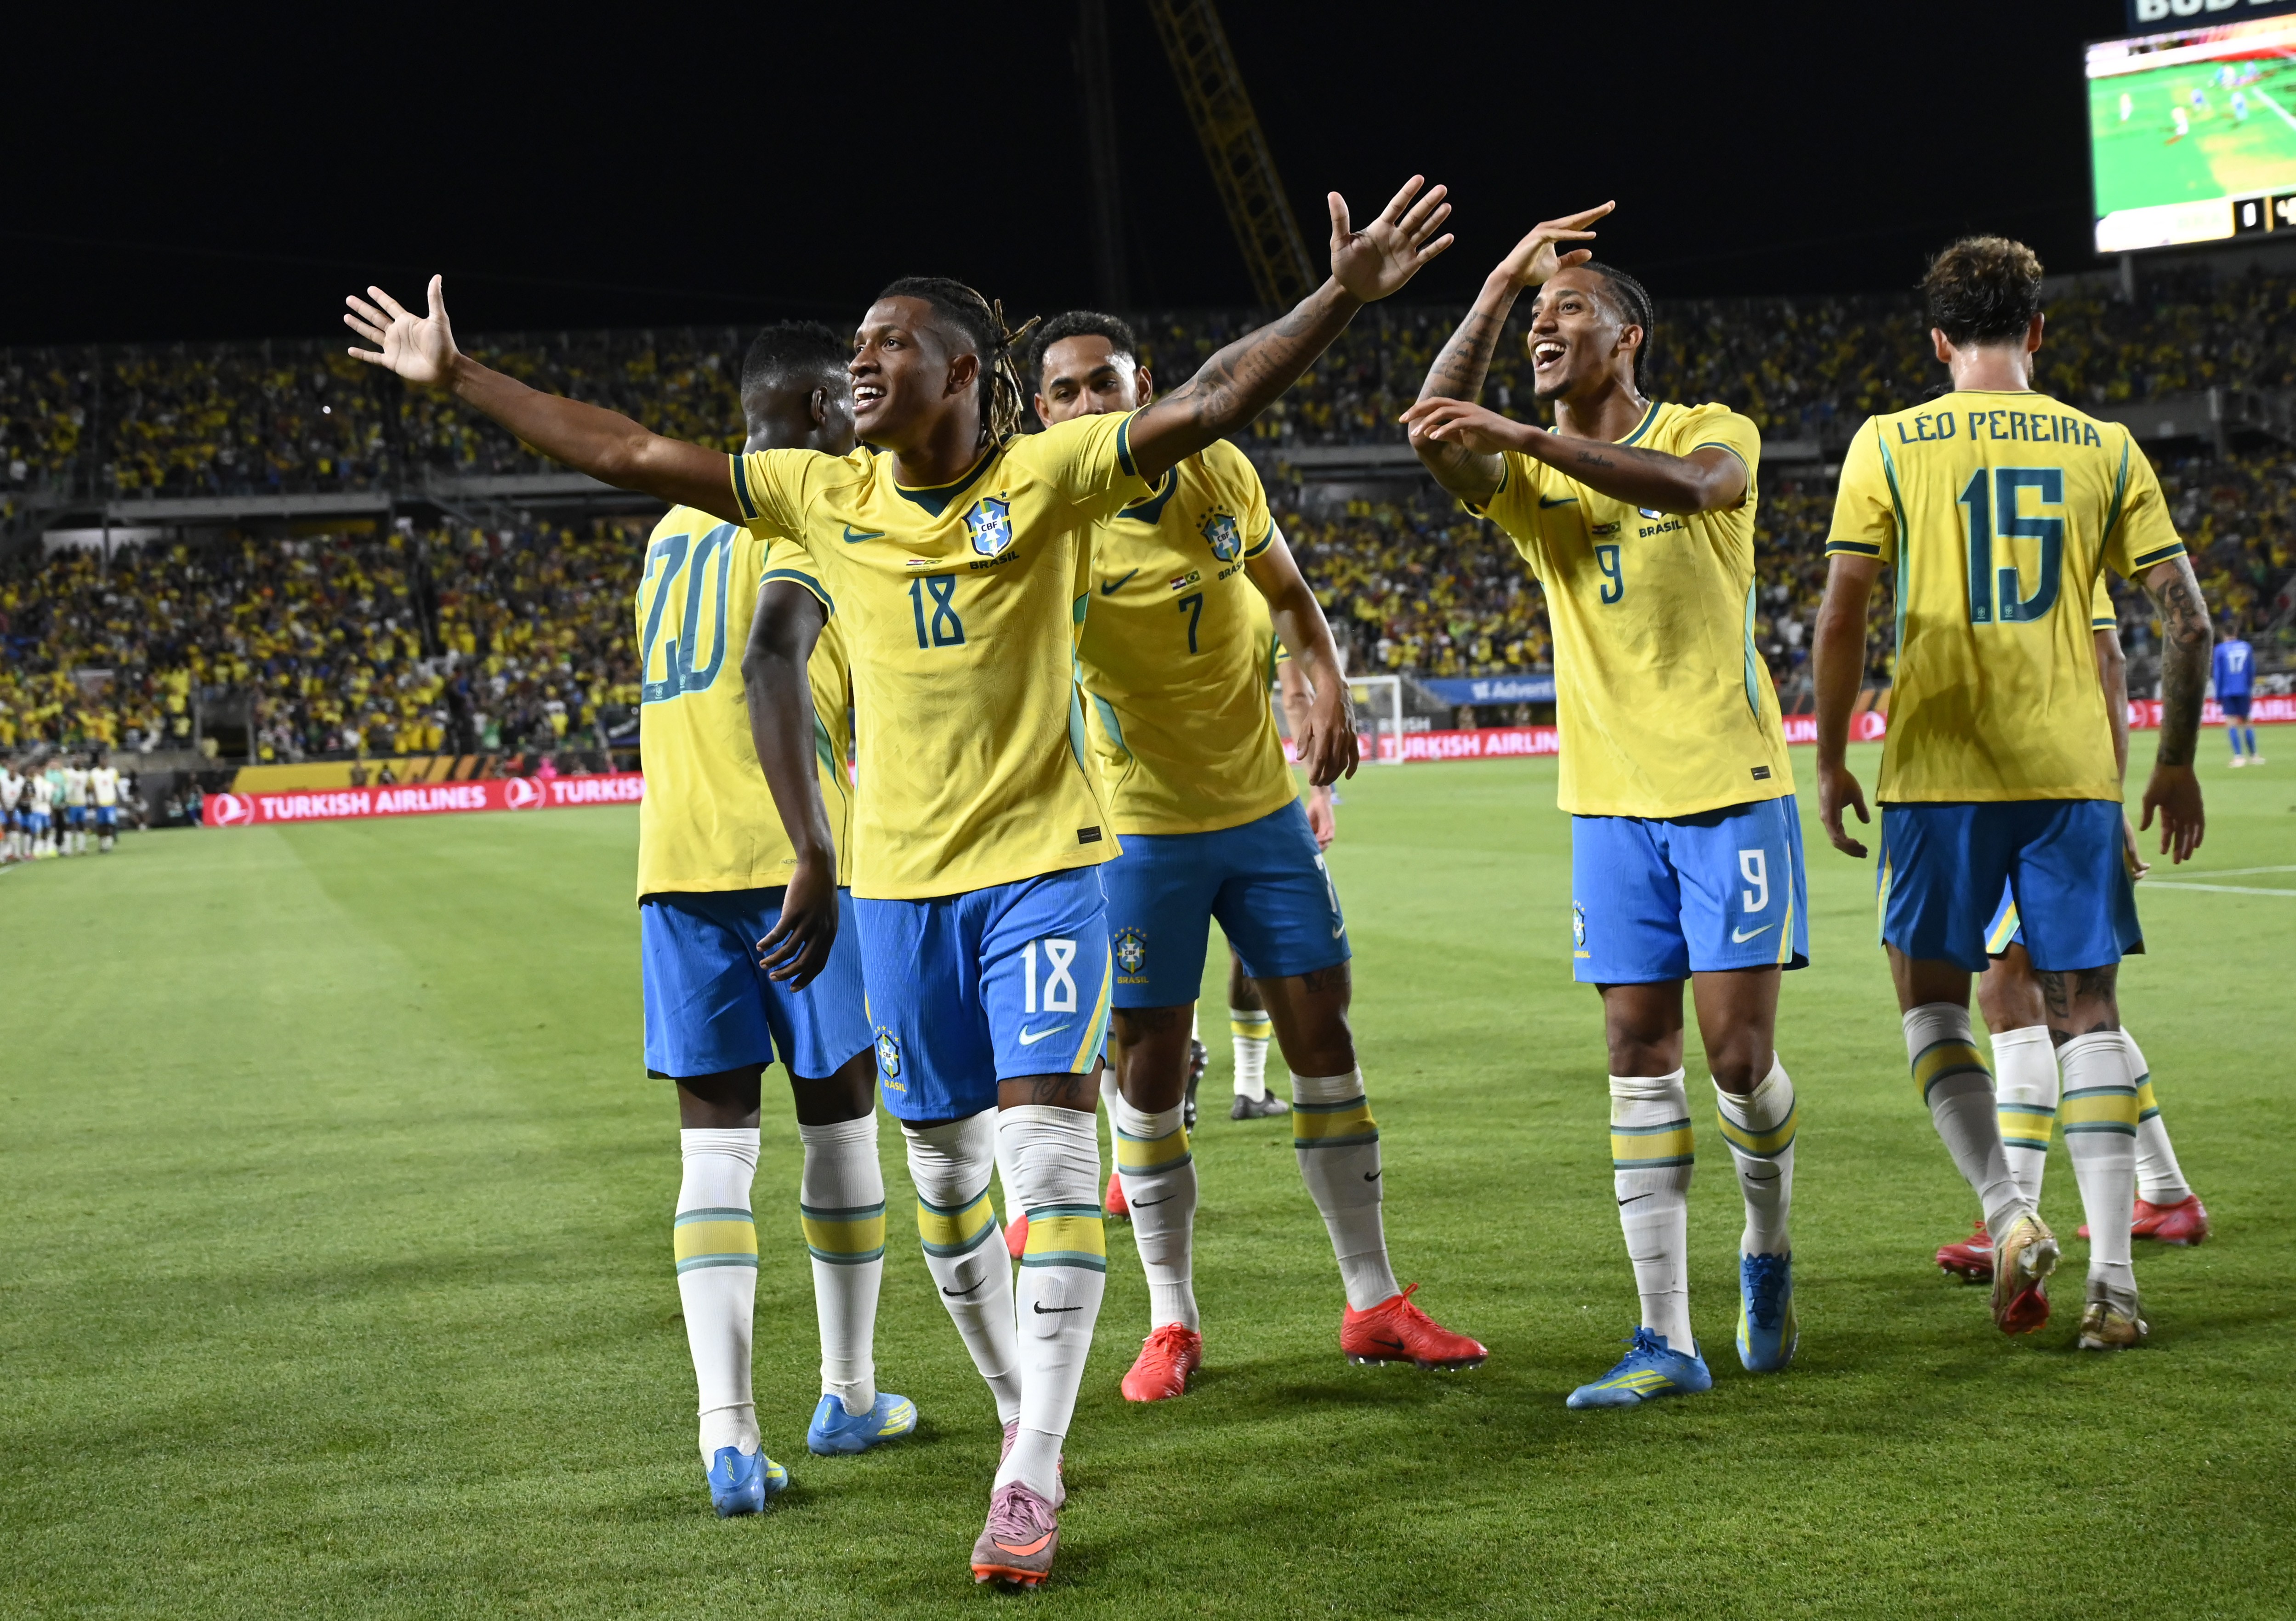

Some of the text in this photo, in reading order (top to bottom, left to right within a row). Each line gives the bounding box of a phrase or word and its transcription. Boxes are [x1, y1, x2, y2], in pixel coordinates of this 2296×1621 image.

[1897, 410, 2102, 448] LÉO PEREIRA
[981, 521, 997, 532] CBF
[1217, 532, 1229, 542] CBF
[1639, 520, 1683, 538] BRASIL
[970, 551, 1020, 569] BRASIL
[1956, 466, 2064, 624] 15
[1595, 545, 1624, 604] 9
[641, 521, 739, 705] 20
[908, 574, 966, 650] 18
[1178, 592, 1204, 654] 7
[2228, 649, 2247, 674] 17
[1485, 731, 1559, 755] AIRLIN
[260, 785, 486, 819] TURKISH AIRLINES
[1738, 849, 1769, 913] 9
[1020, 938, 1077, 1013] 18
[884, 1080, 907, 1092] RASIL
